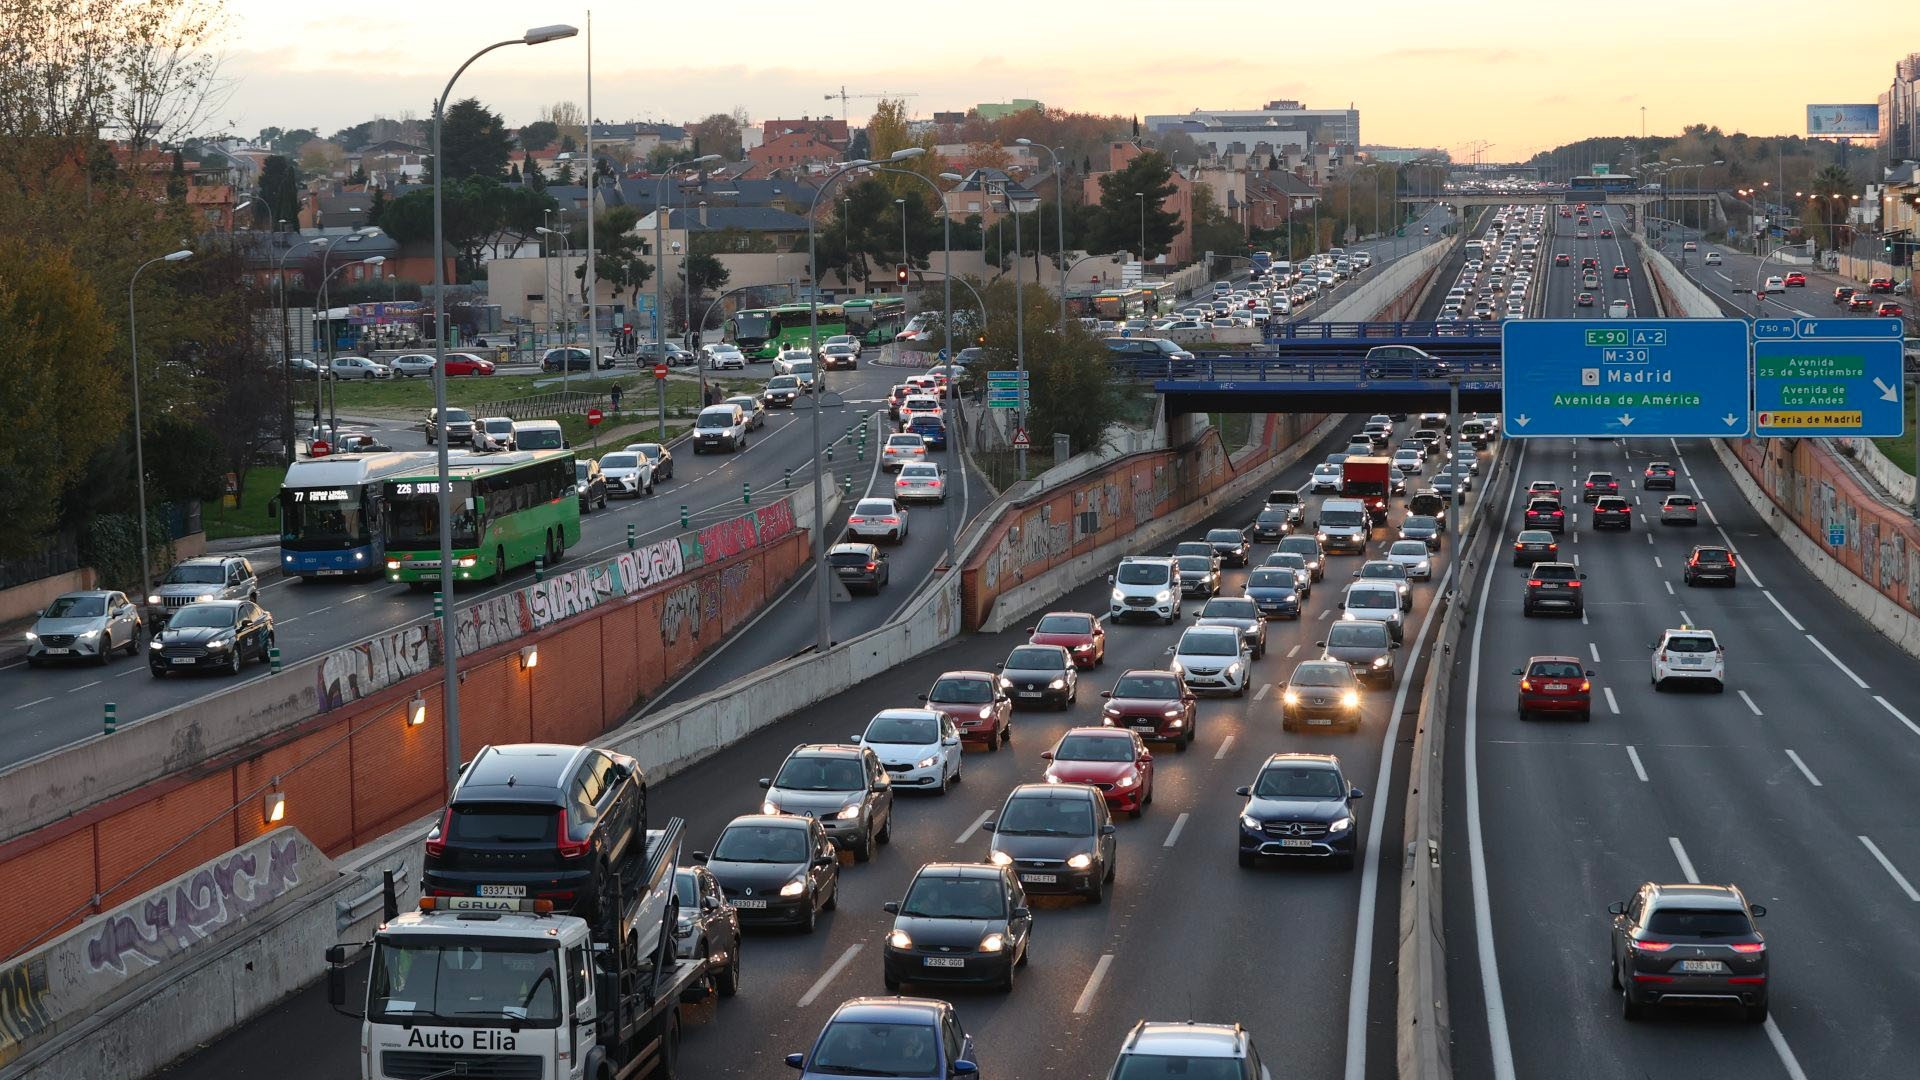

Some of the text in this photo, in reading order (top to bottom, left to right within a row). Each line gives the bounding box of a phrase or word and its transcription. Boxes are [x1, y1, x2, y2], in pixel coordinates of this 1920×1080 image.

[1588, 332, 1664, 343] E-90 A-2
[1605, 350, 1646, 362] M-30
[1789, 358, 1834, 367] Avenida
[1607, 369, 1671, 383] Madrid
[1760, 368, 1863, 379] 25 de Septiembre
[1782, 386, 1845, 394] Avenida de
[1554, 393, 1700, 405] Avenida de América
[1784, 396, 1844, 405] Los Andes
[1773, 415, 1861, 424] Feria de Madrid
[396, 483, 412, 494] 226
[294, 492, 304, 502] 77
[482, 886, 525, 896] 9337 LVM
[457, 901, 511, 910] GRUA
[752, 900, 765, 908] FZZ
[929, 958, 946, 966] 2392
[1686, 961, 1704, 969] 2035
[407, 1028, 516, 1051] Auto Elia
